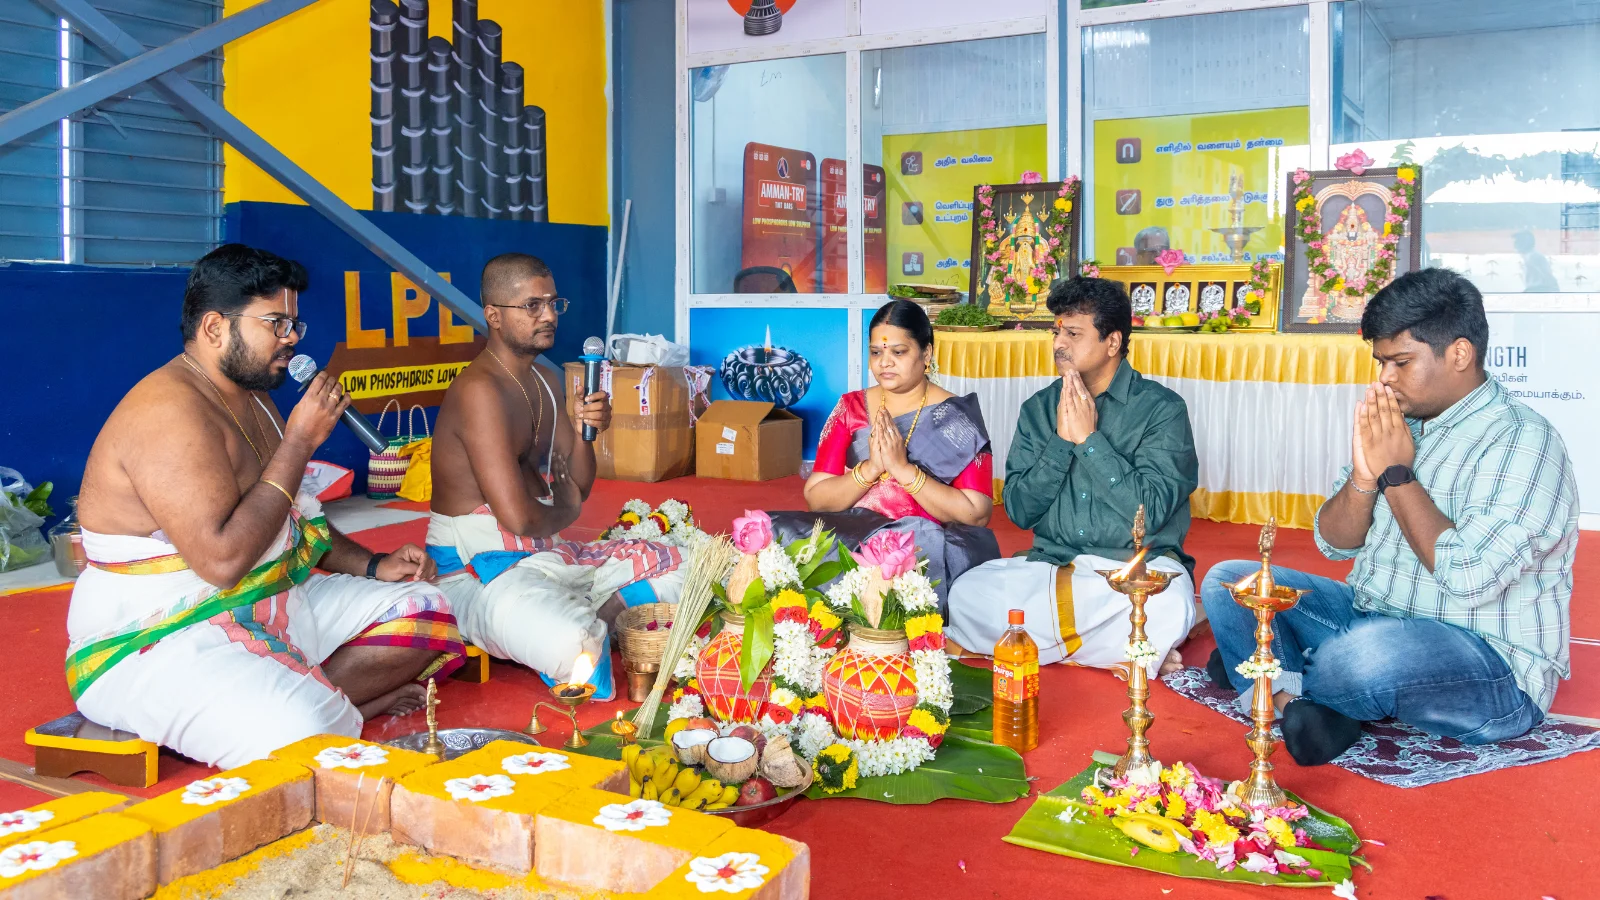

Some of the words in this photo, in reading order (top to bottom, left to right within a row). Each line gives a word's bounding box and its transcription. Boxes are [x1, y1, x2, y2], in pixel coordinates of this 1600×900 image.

[1155, 142, 1192, 154] எளிதில்
[1197, 139, 1241, 151] வளையும்
[1246, 138, 1283, 150] தன்மை
[935, 156, 957, 167] அதிக
[961, 154, 993, 164] வலிமை
[760, 183, 805, 202] AMMAN-TRY
[936, 200, 974, 210] வெளிப்புற
[935, 212, 968, 222] உட்புறம்
[936, 257, 958, 268] அதிக
[1244, 252, 1251, 261] &
[344, 375, 367, 393] LOW
